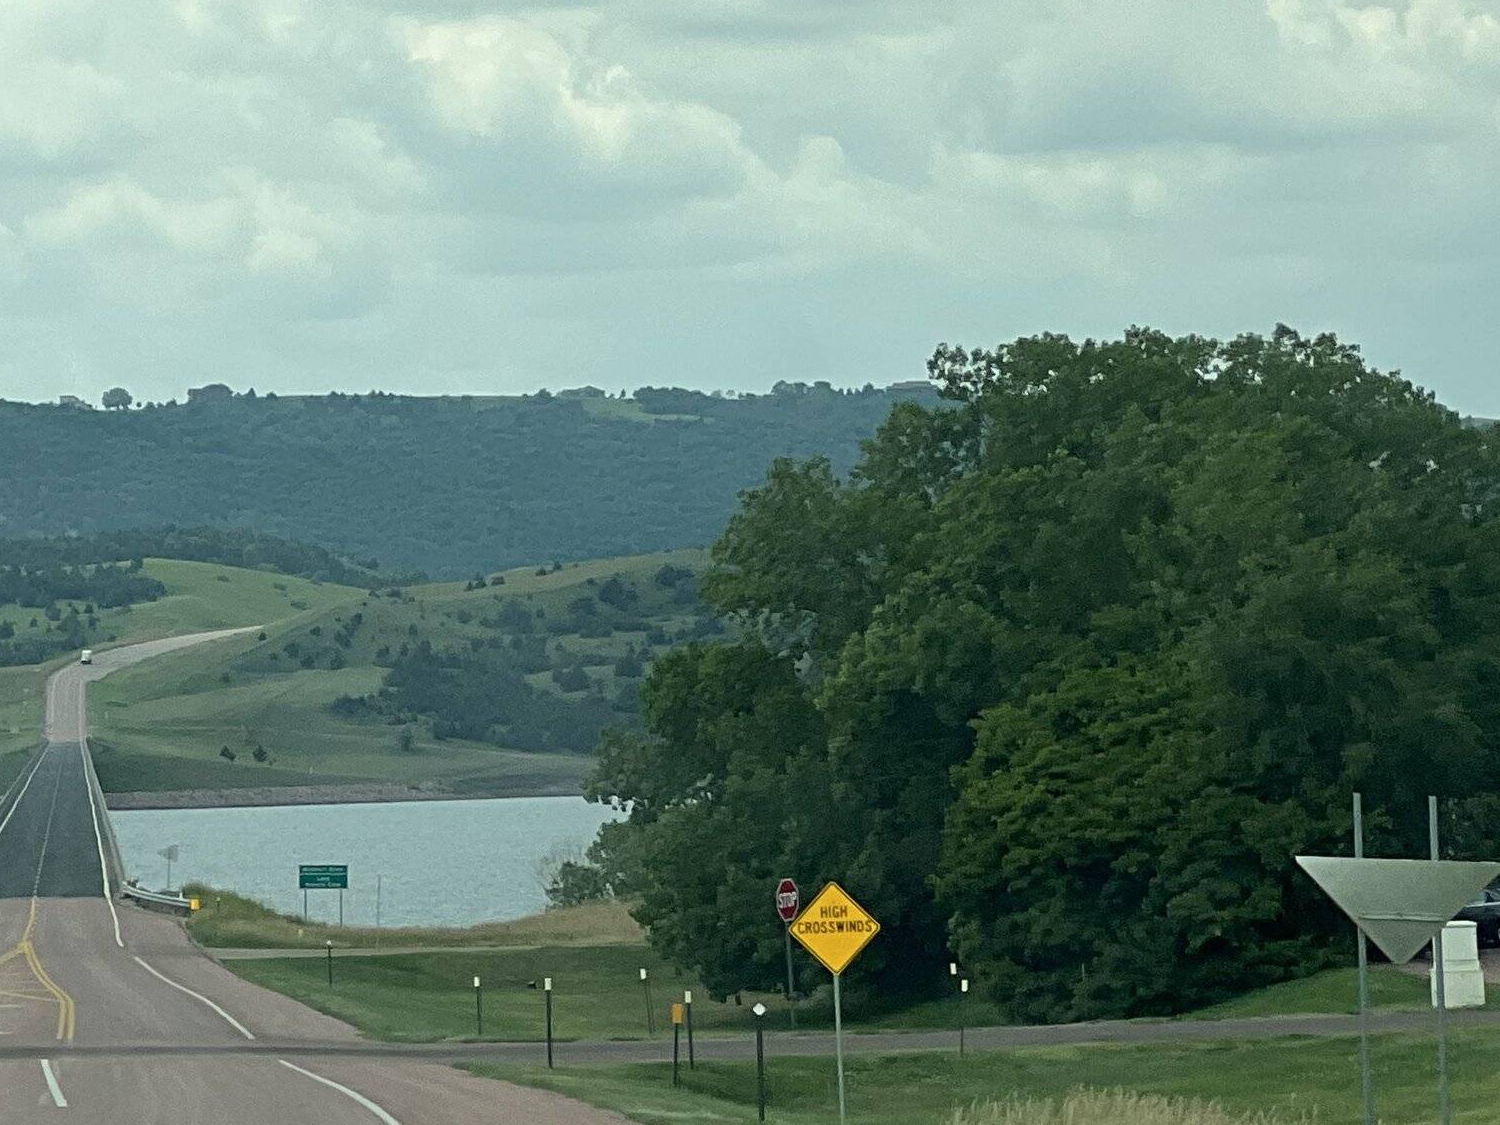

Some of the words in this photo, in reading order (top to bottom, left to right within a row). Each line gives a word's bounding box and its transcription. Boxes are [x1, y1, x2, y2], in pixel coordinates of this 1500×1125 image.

[778, 891, 797, 909] STOP
[820, 906, 848, 918] HIGH
[797, 920, 873, 934] CROSSWINDS
